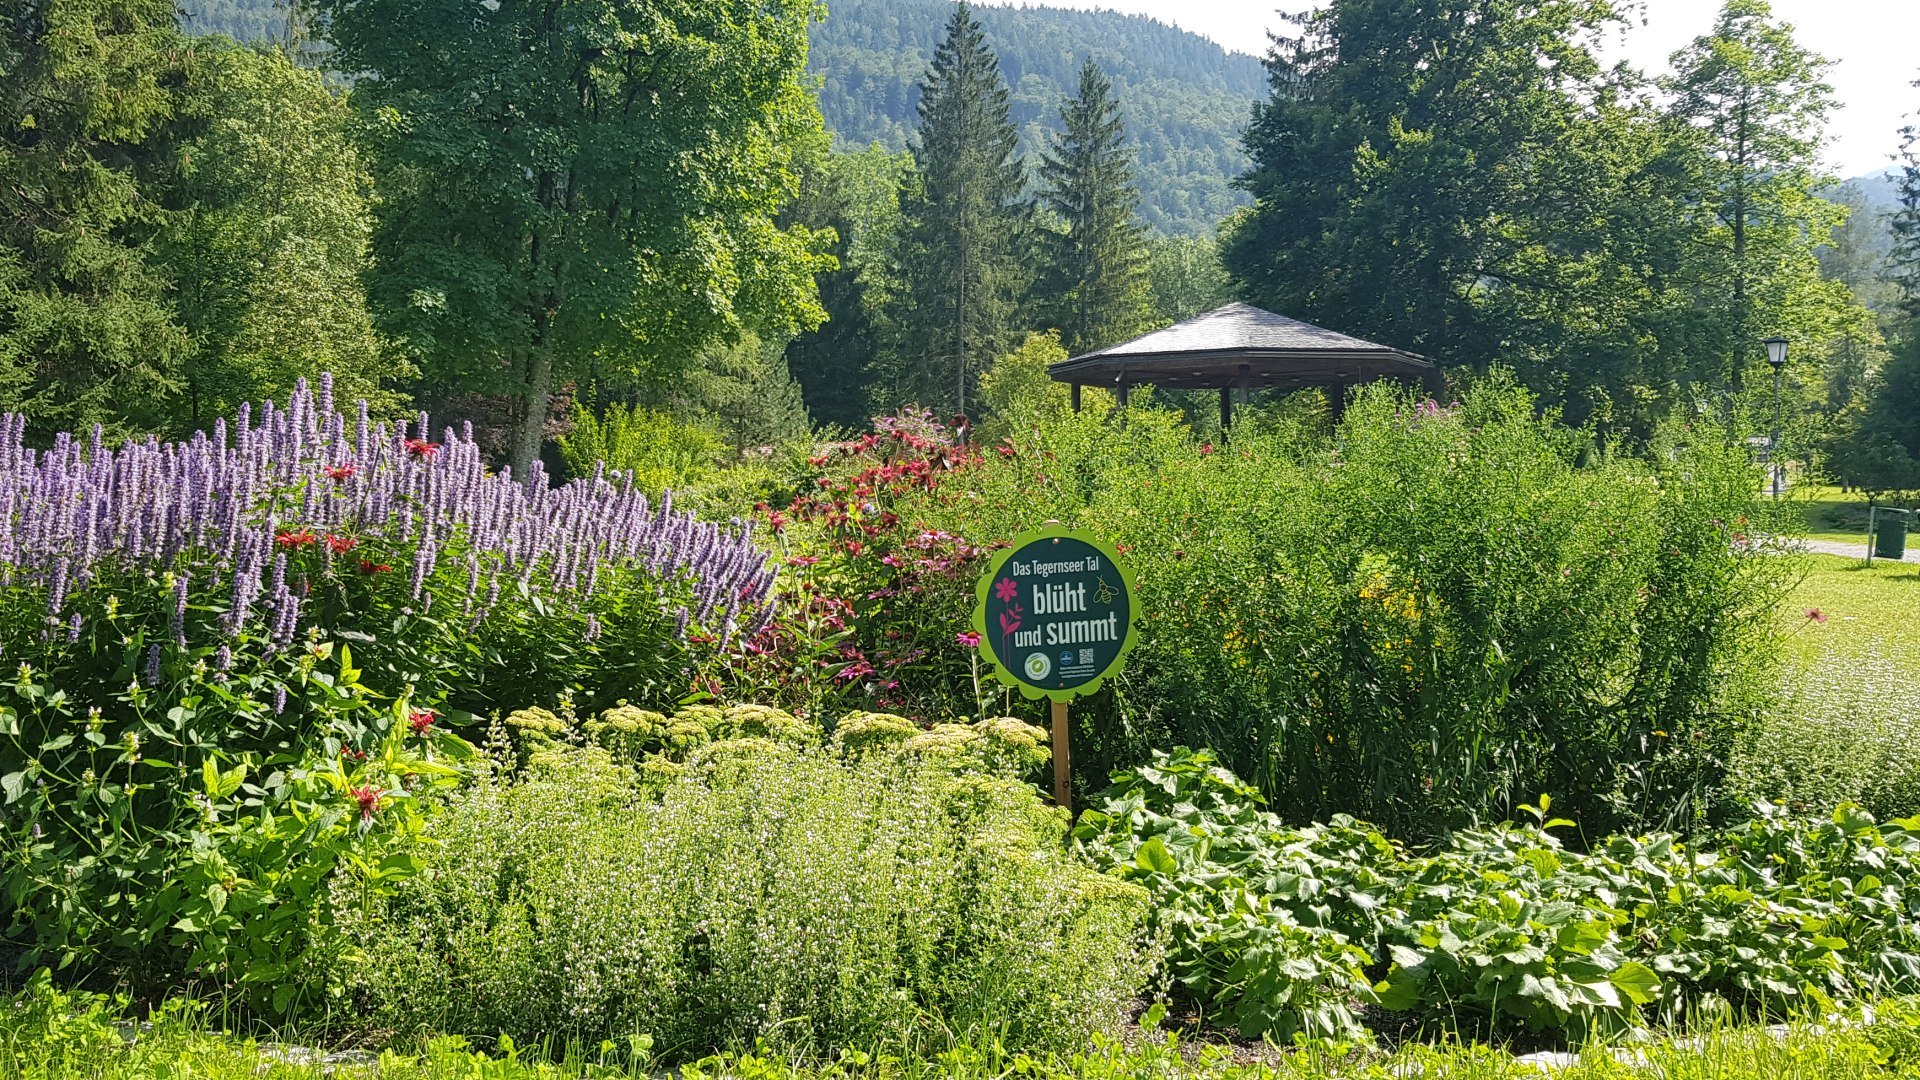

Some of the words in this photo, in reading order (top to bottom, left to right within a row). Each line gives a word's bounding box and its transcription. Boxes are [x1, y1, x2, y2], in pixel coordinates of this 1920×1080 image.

[1012, 561, 1031, 576] Das
[1032, 559, 1084, 578] Tegernseer
[1085, 556, 1099, 571] Tal
[1032, 582, 1087, 615] blüht
[1014, 625, 1042, 648] und
[1046, 611, 1118, 645] summt
